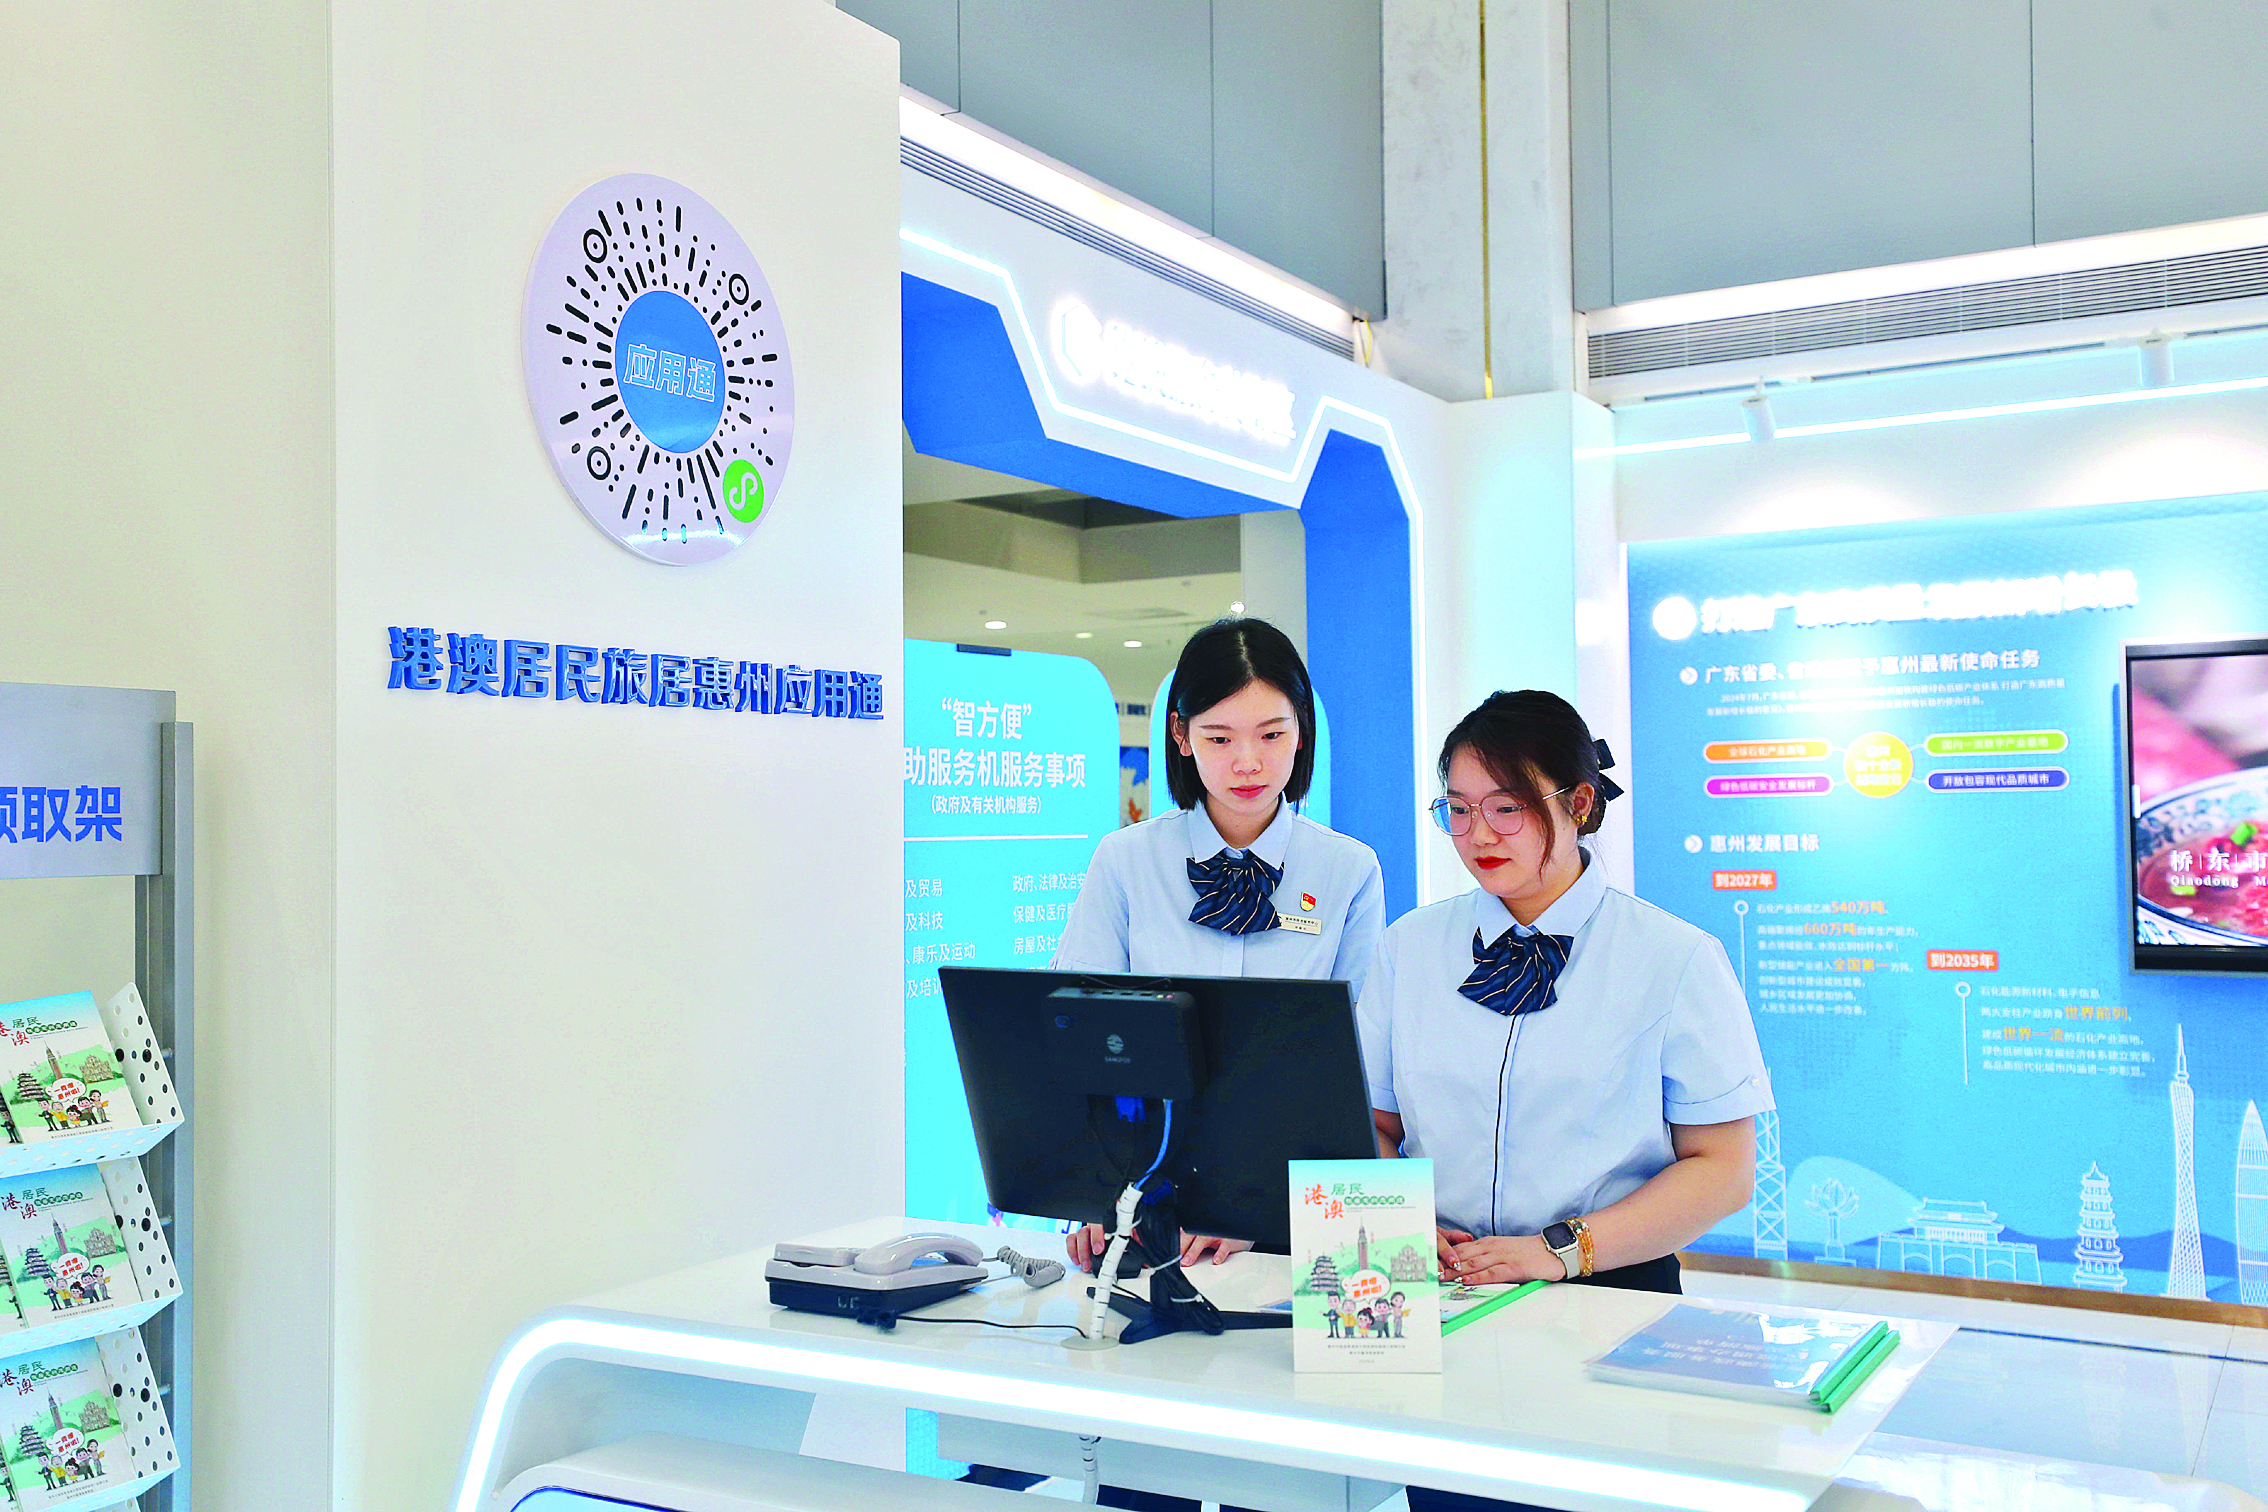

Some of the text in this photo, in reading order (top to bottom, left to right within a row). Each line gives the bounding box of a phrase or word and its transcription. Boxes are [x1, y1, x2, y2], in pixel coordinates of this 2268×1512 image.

[623, 343, 717, 403] 应用通
[387, 626, 885, 721] 港澳居民旅居惠州应用通
[941, 697, 1032, 739] “智方便”
[904, 746, 1086, 788] 助服务机服务事项
[1942, 773, 2050, 787] 开放包容现代品质城市
[931, 795, 1041, 814] （政府及有关机构服务）
[1709, 833, 1820, 853] 惠州发展目标
[905, 878, 943, 899] 及贸易
[1715, 872, 1774, 889] 到2027年
[2170, 874, 2239, 889] Qiaodong
[905, 911, 944, 932] 及科技
[1930, 952, 1995, 970] 到2035年
[906, 977, 944, 998] 及培训
[22, 1187, 49, 1200] 居民
[1331, 1183, 1365, 1195] 居民
